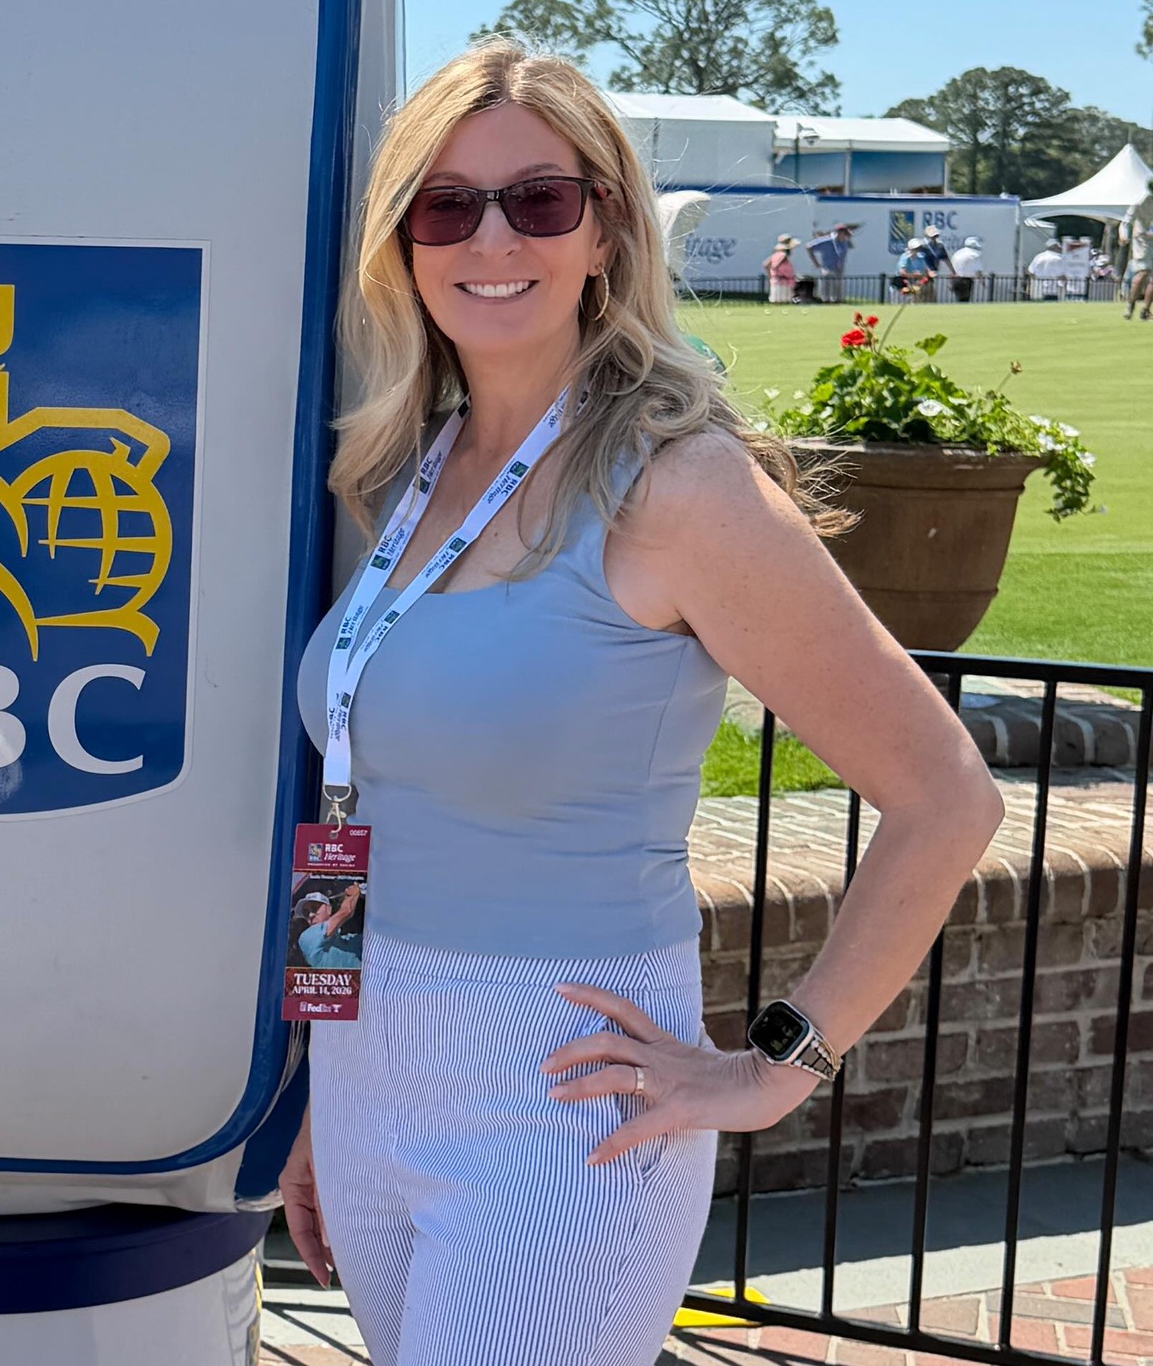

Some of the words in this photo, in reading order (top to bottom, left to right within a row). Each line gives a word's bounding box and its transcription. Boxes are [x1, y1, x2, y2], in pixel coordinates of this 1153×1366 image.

[922, 210, 958, 230] RBC
[377, 534, 393, 554] RBC
[324, 843, 344, 853] RBC
[293, 972, 353, 986] TUESDAY
[291, 985, 318, 995] APRIL
[331, 986, 352, 995] 2026
